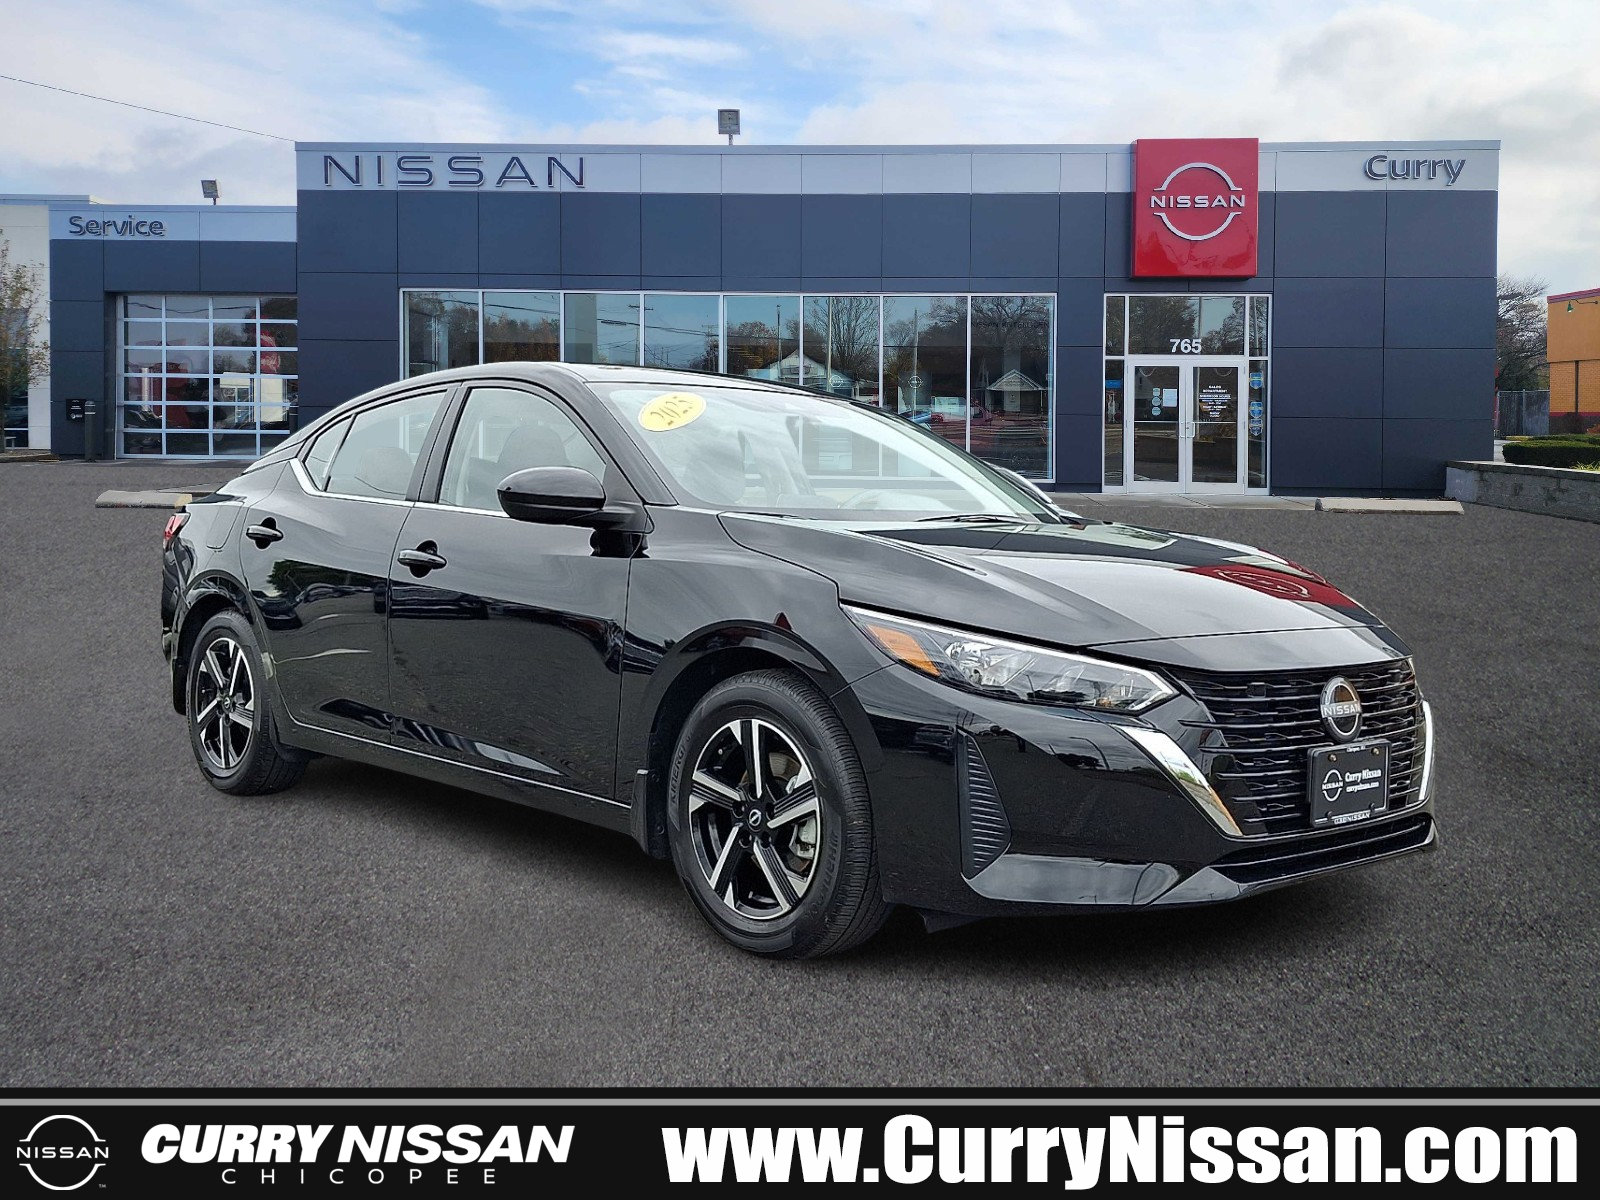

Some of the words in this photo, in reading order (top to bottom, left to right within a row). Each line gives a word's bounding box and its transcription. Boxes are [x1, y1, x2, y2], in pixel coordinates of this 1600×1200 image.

[324, 155, 585, 188] NISSAN
[1365, 154, 1467, 186] Curry
[1150, 194, 1246, 209] NISSAN
[68, 214, 166, 237] Service
[1169, 338, 1202, 353] 765
[1323, 703, 1360, 717] NISSAN
